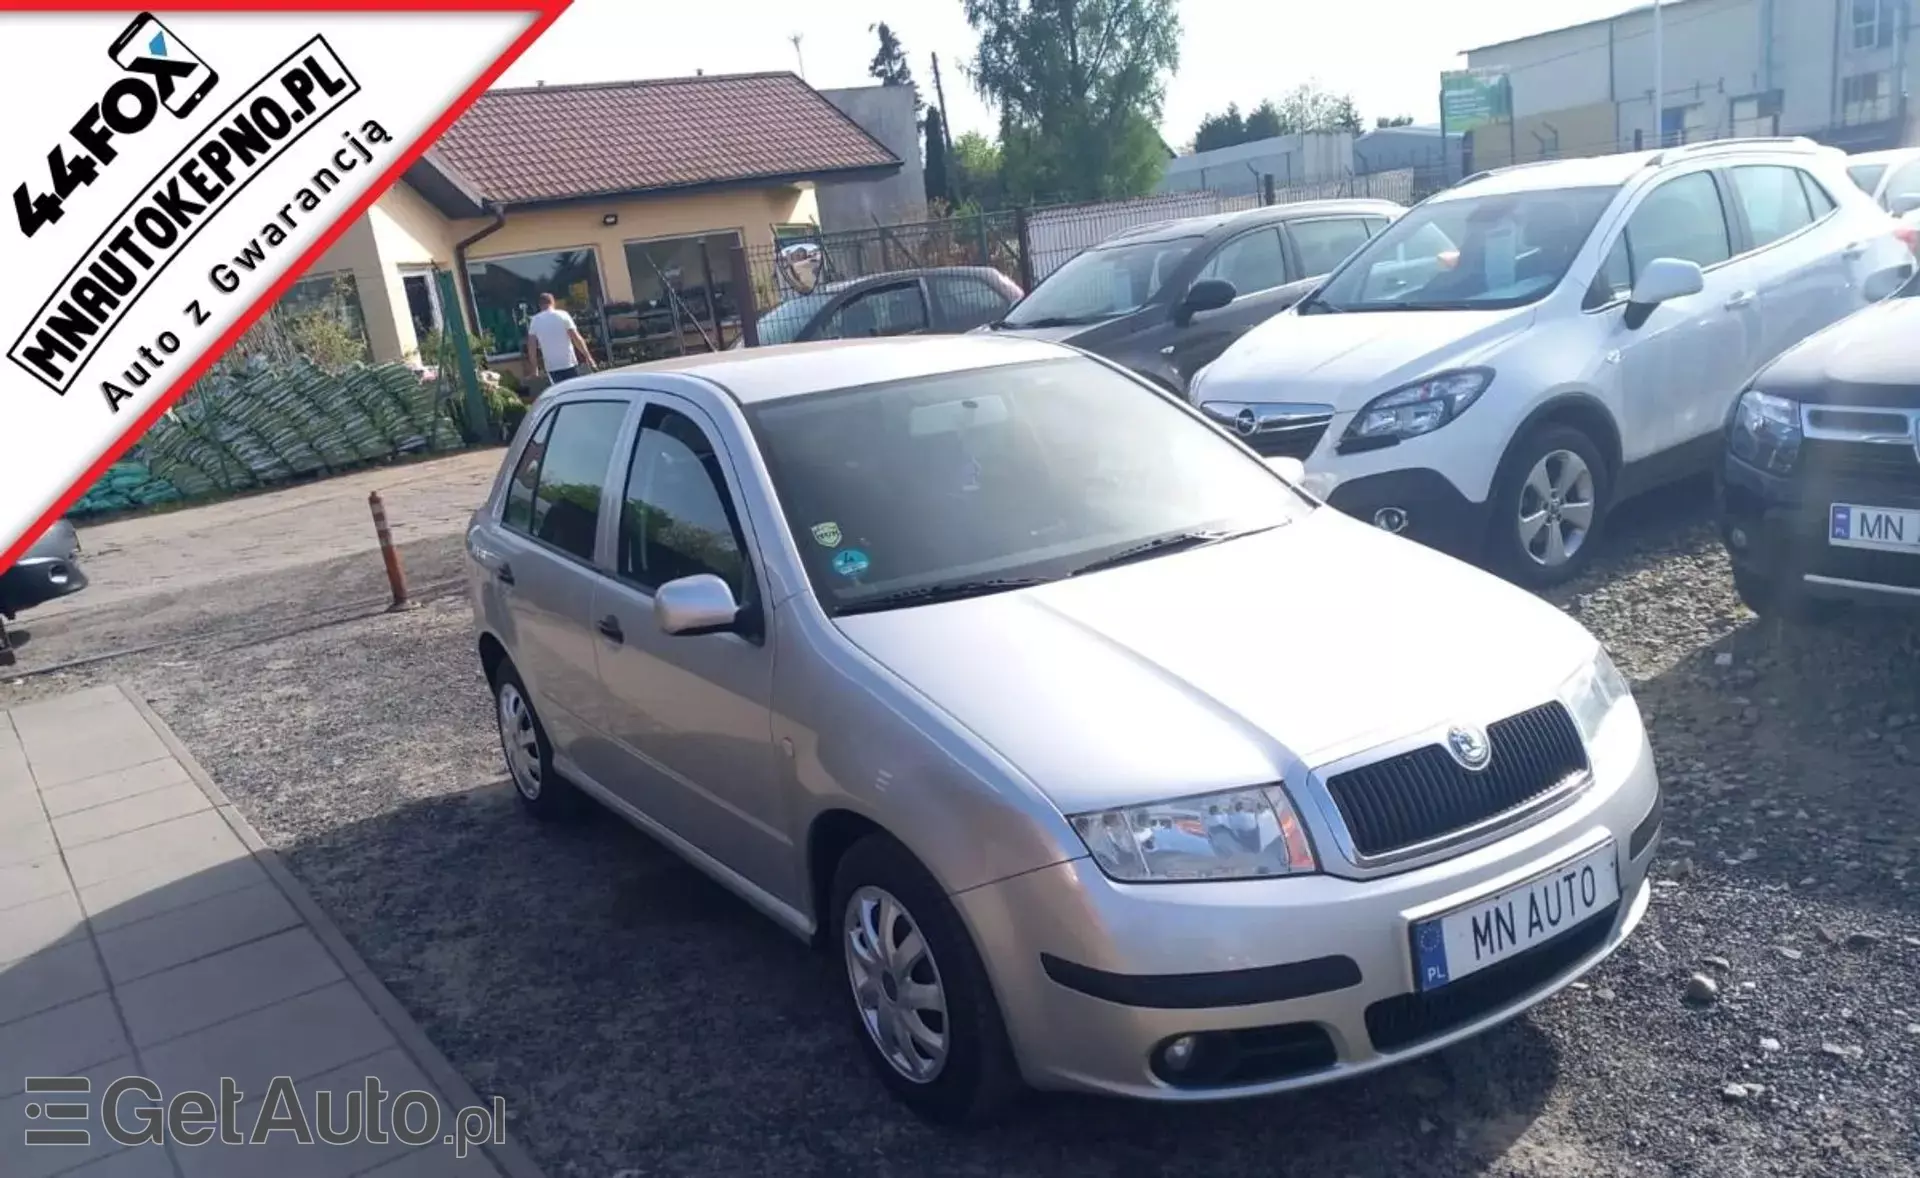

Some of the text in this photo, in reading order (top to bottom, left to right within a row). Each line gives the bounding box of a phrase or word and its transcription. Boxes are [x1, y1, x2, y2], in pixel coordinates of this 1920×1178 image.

[1860, 512, 1904, 541] MN
[1427, 865, 1597, 982] PL MN AUTO
